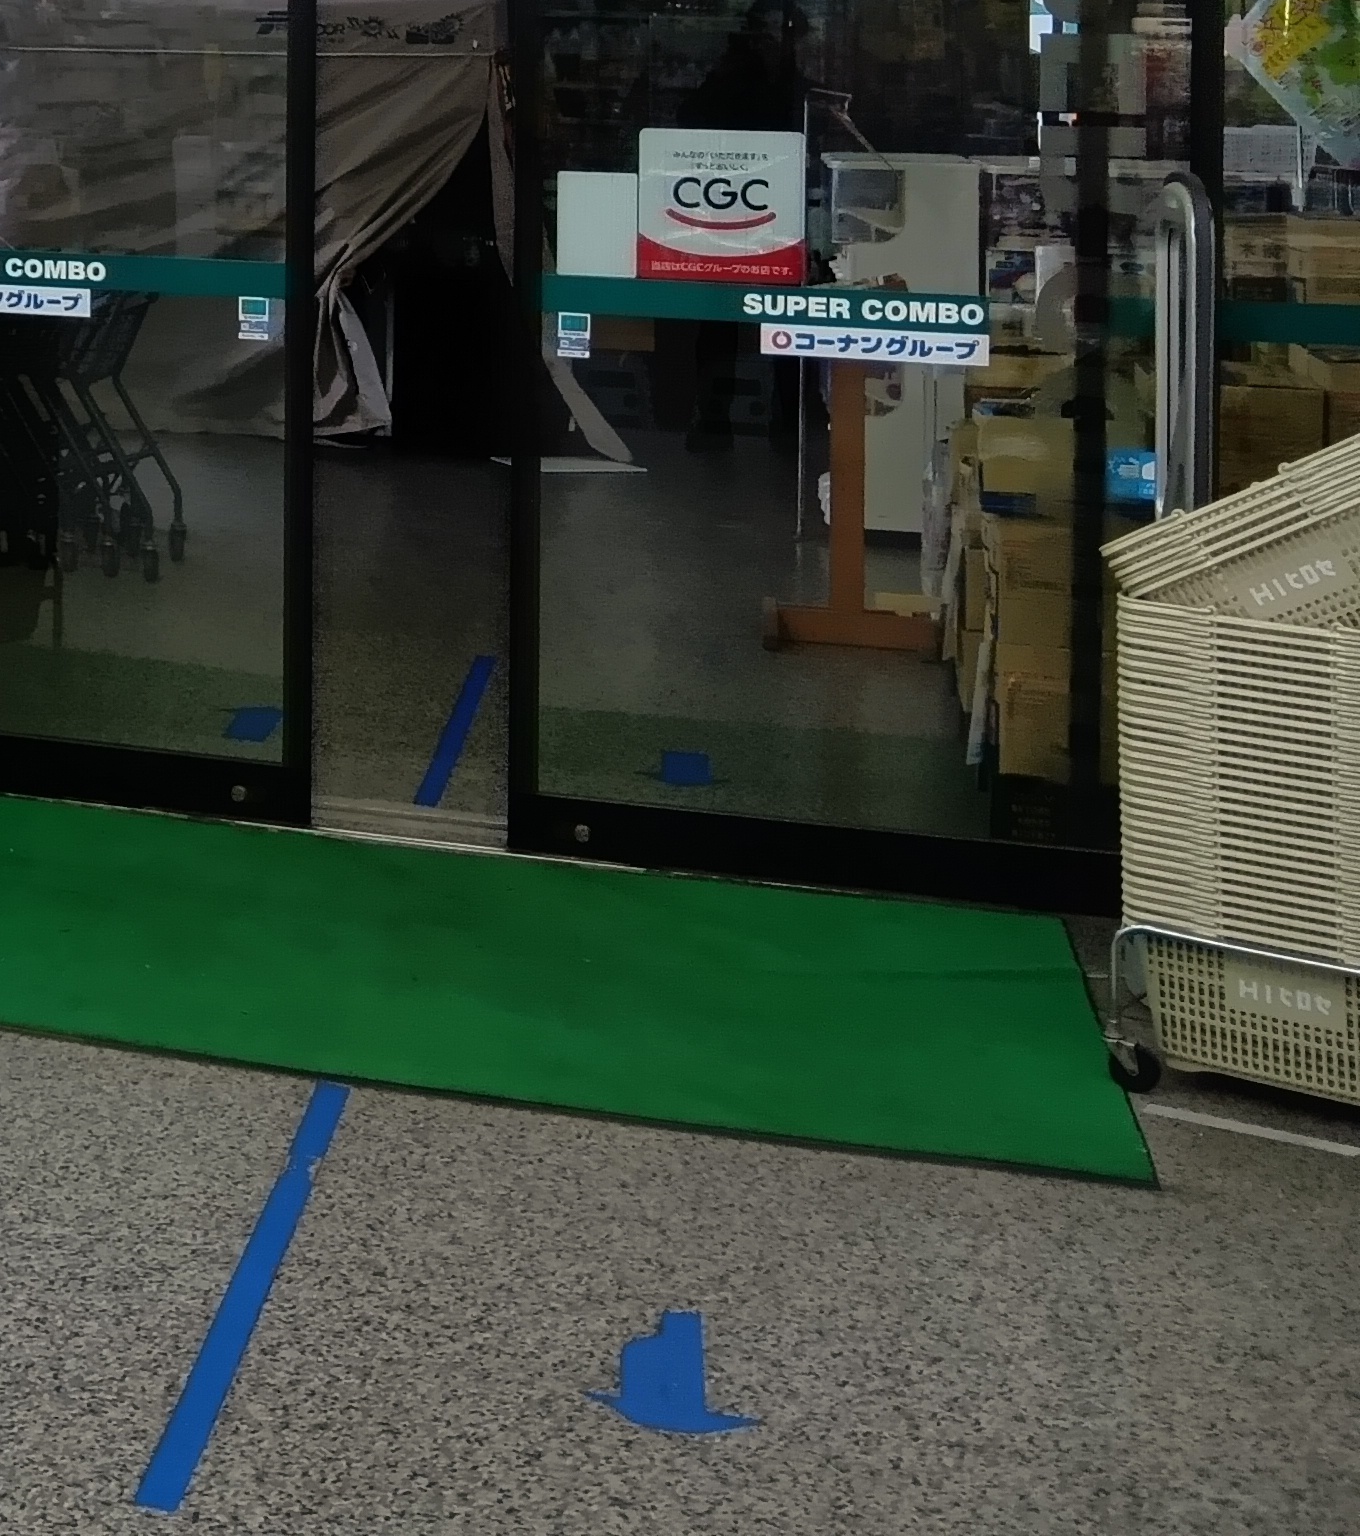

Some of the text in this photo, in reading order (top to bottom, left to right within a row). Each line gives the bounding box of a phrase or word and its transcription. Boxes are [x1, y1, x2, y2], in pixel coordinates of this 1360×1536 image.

[672, 176, 770, 212] CGC
[4, 256, 107, 283] COMBO
[742, 293, 986, 326] SUPER COMBO
[794, 331, 981, 361] コーナングループ
